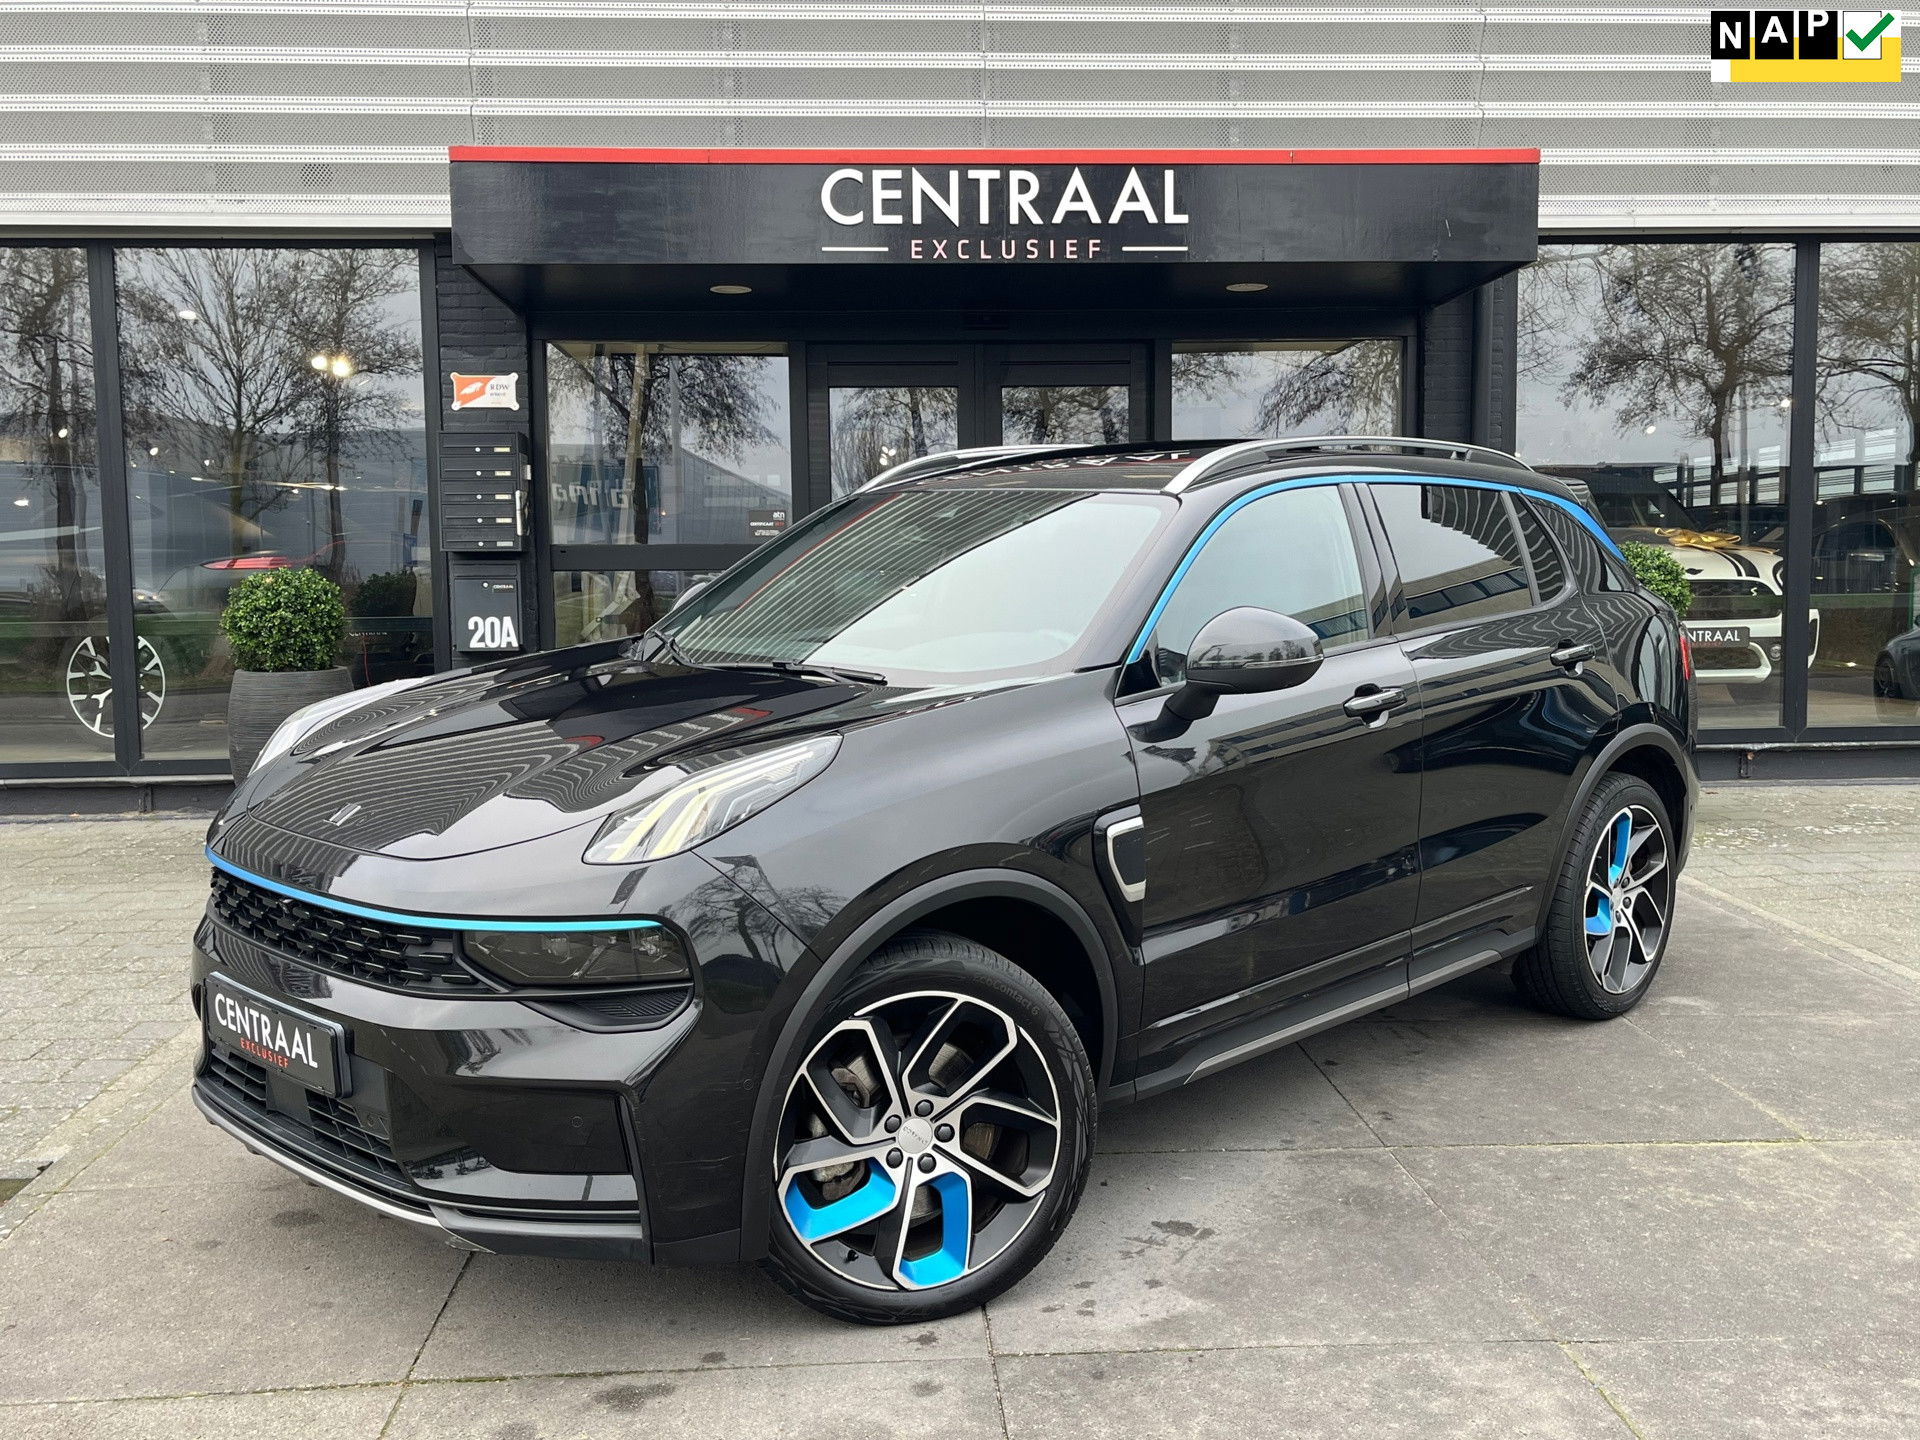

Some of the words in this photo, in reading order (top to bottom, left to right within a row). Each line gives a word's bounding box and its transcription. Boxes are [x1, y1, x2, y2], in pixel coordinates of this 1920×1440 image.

[820, 166, 1189, 228] CENTRAAL
[911, 239, 1102, 260] EXCLUSIEF
[467, 615, 519, 649] 20A
[1688, 629, 1740, 642] NTRAAL
[214, 993, 319, 1069] CENTRAAL
[239, 1037, 290, 1069] EXCLUSIEF
